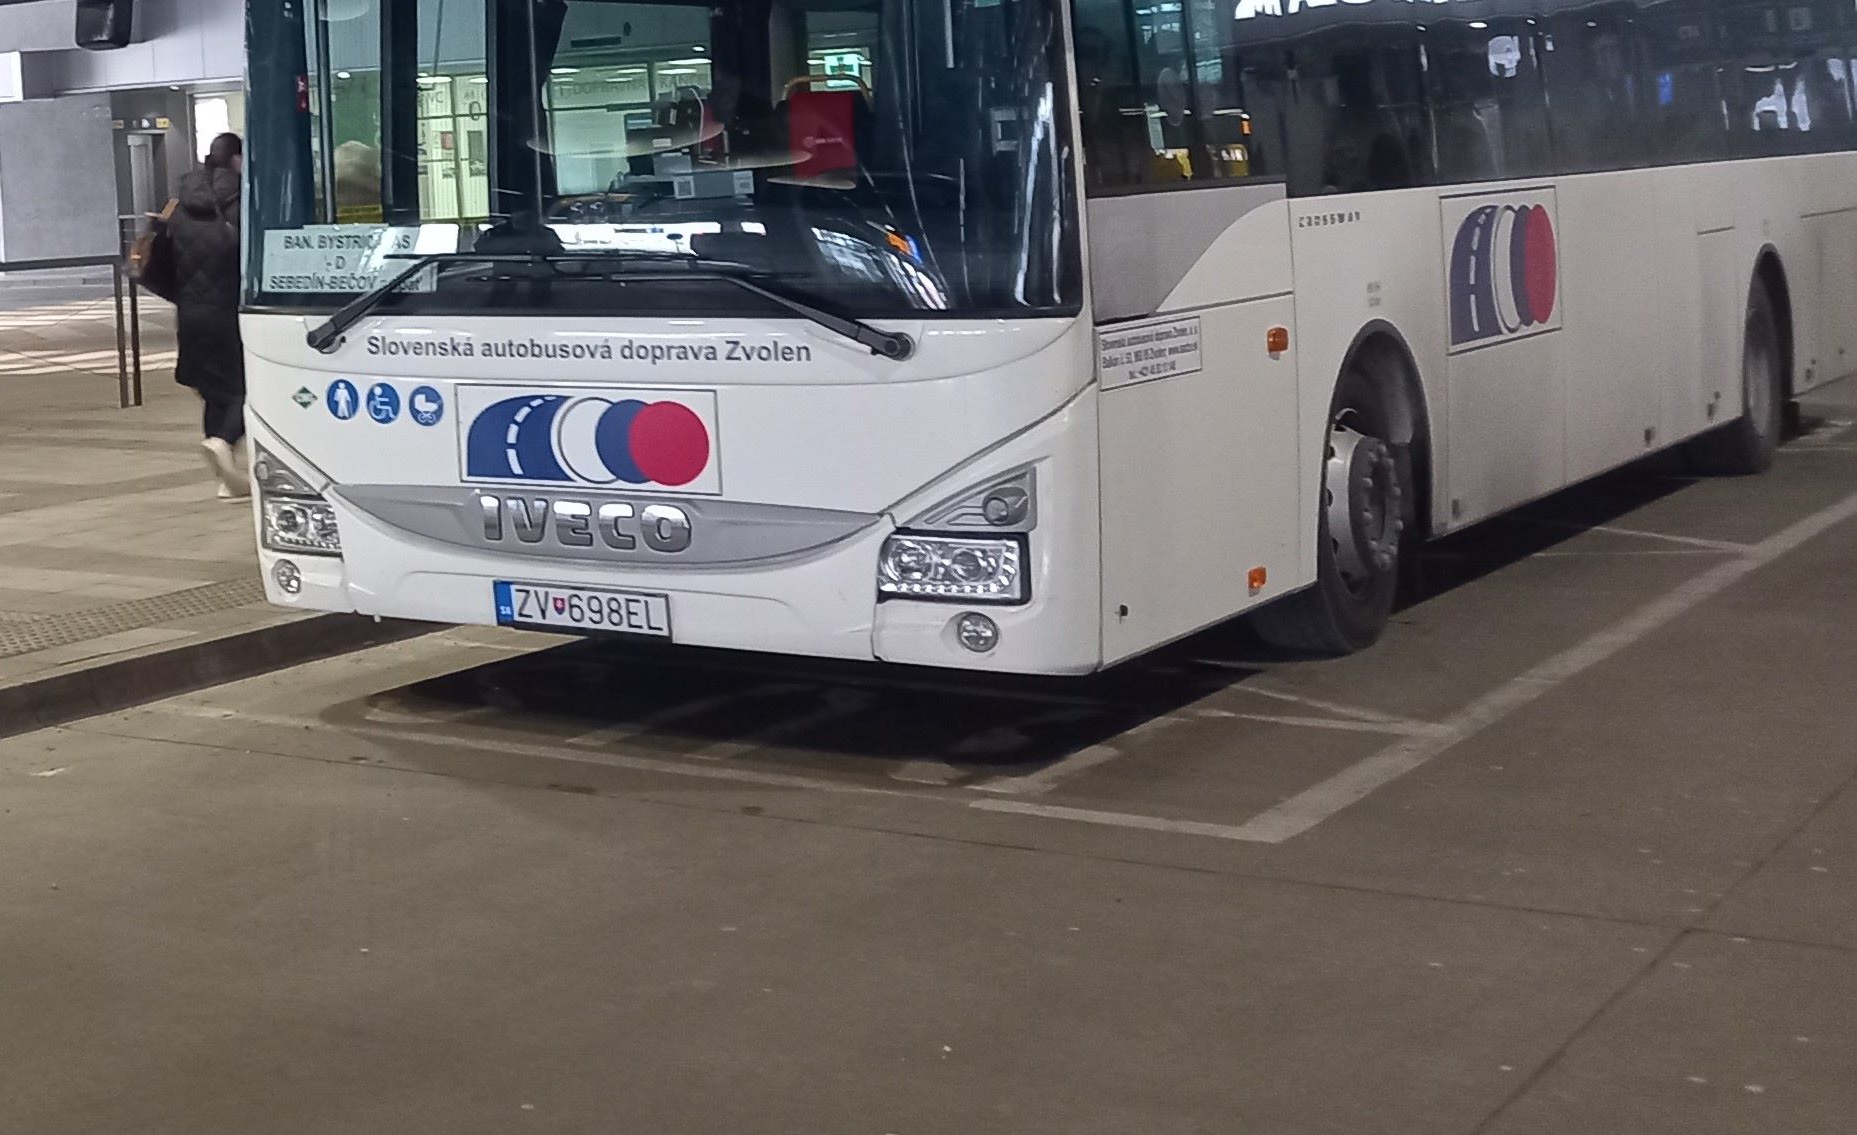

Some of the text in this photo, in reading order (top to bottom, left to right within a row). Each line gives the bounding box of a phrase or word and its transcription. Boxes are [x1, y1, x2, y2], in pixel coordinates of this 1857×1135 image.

[284, 235, 314, 249] BAN.
[318, 234, 384, 250] BYSTRIC
[367, 336, 811, 365] Slovenská autobusová doprava Zvolen
[480, 494, 692, 553] IVECO
[515, 588, 550, 620] ZV
[567, 593, 664, 632] 698EL
